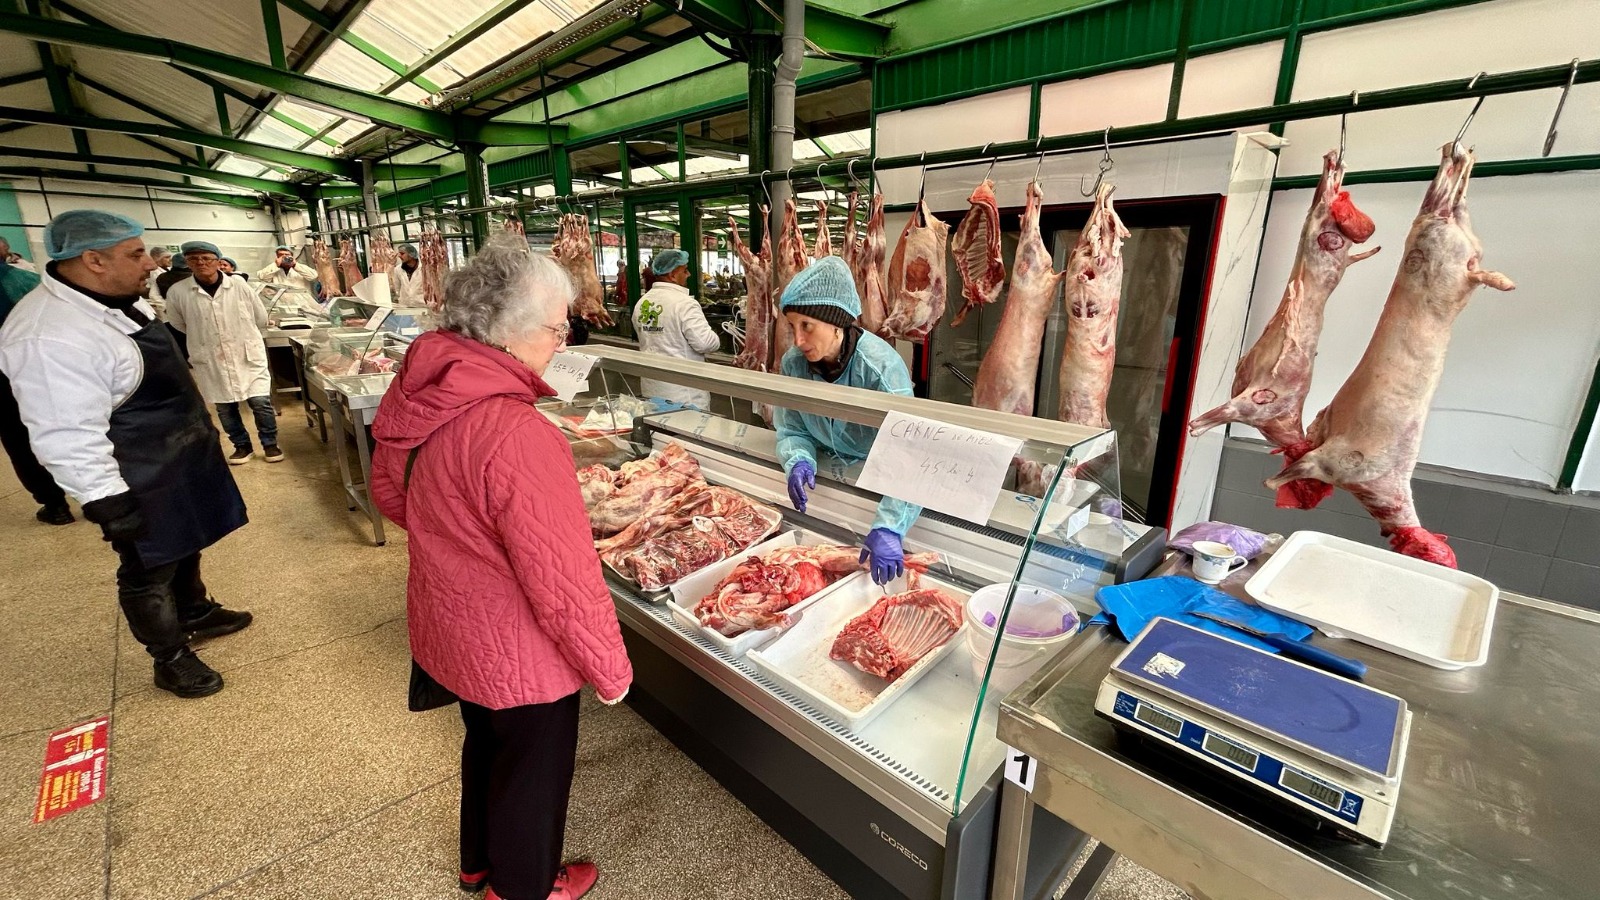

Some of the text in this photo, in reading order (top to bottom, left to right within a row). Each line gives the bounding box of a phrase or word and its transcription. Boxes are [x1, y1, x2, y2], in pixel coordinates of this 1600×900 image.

[890, 419, 949, 441] CARNE
[920, 457, 942, 475] 45
[1013, 754, 1030, 785] 1
[880, 830, 928, 871] CORECO
